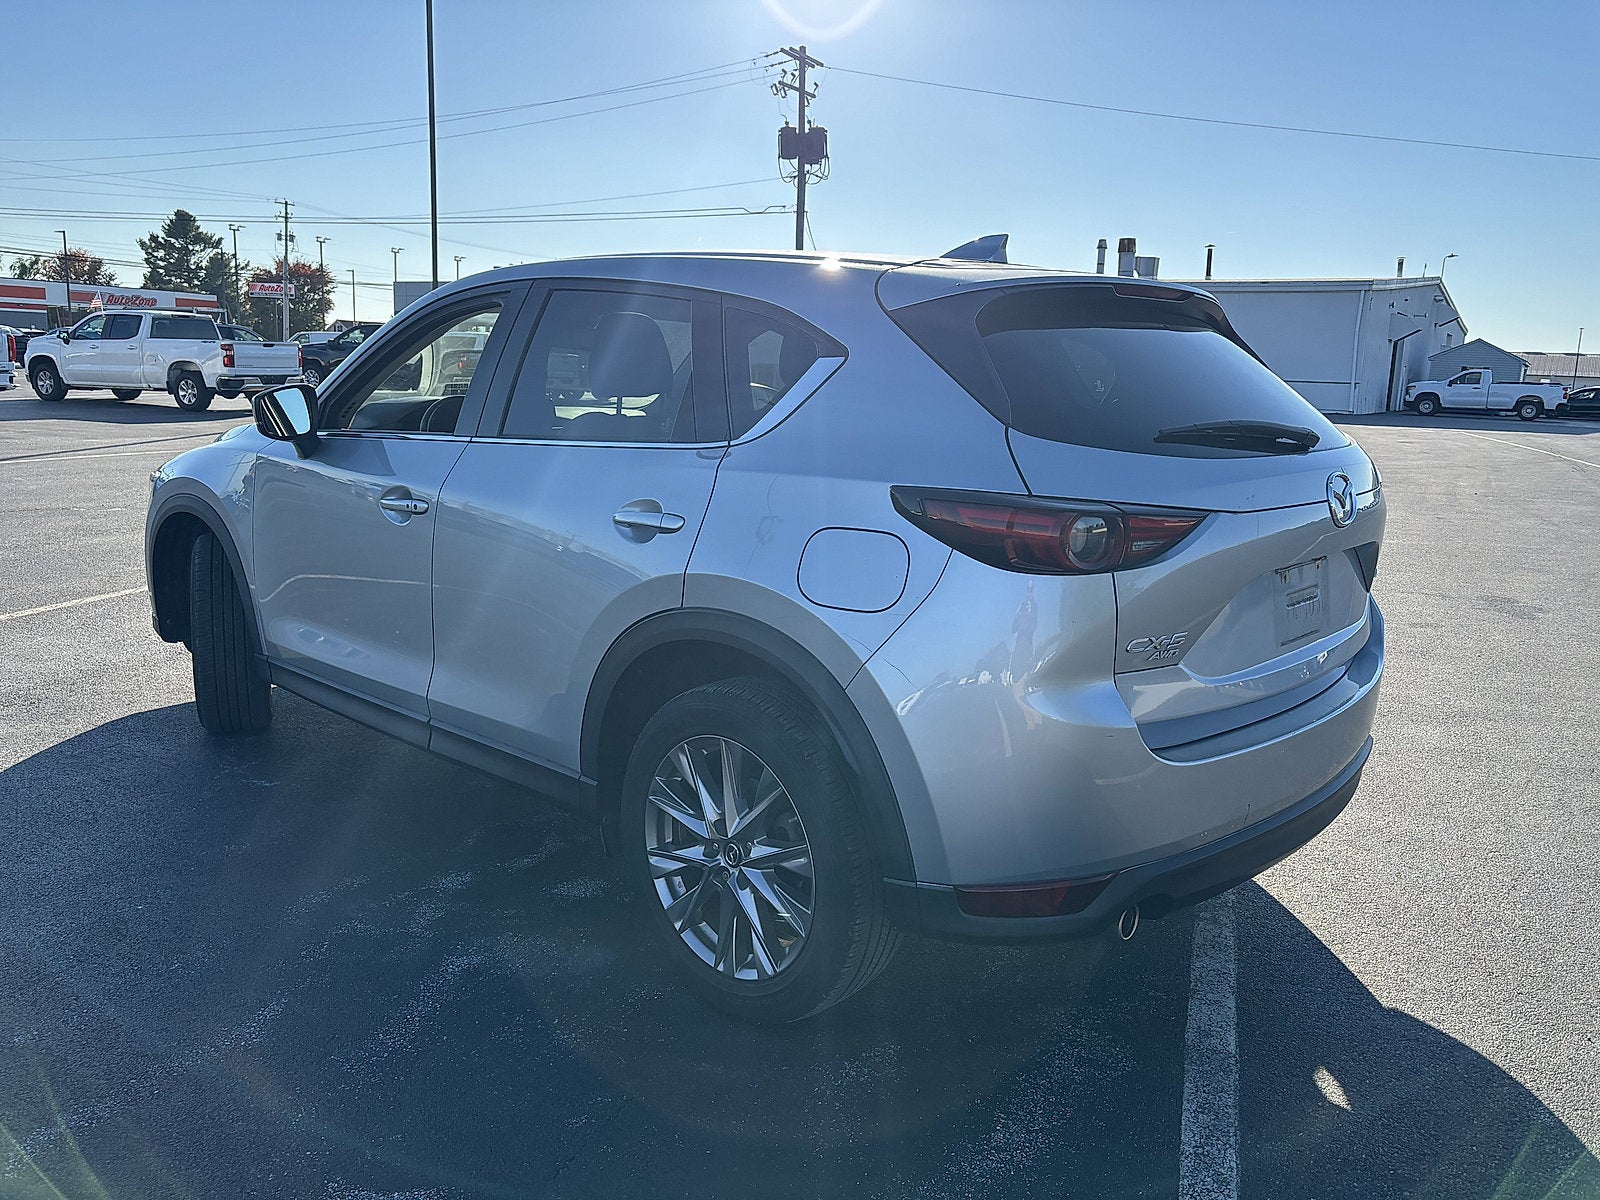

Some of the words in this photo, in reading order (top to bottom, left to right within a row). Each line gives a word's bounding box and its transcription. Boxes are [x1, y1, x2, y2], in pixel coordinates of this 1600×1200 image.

[258, 284, 292, 293] AutoZoe
[106, 294, 158, 307] AutoZone
[1126, 631, 1189, 654] CX-5
[1147, 649, 1179, 661] AWD
